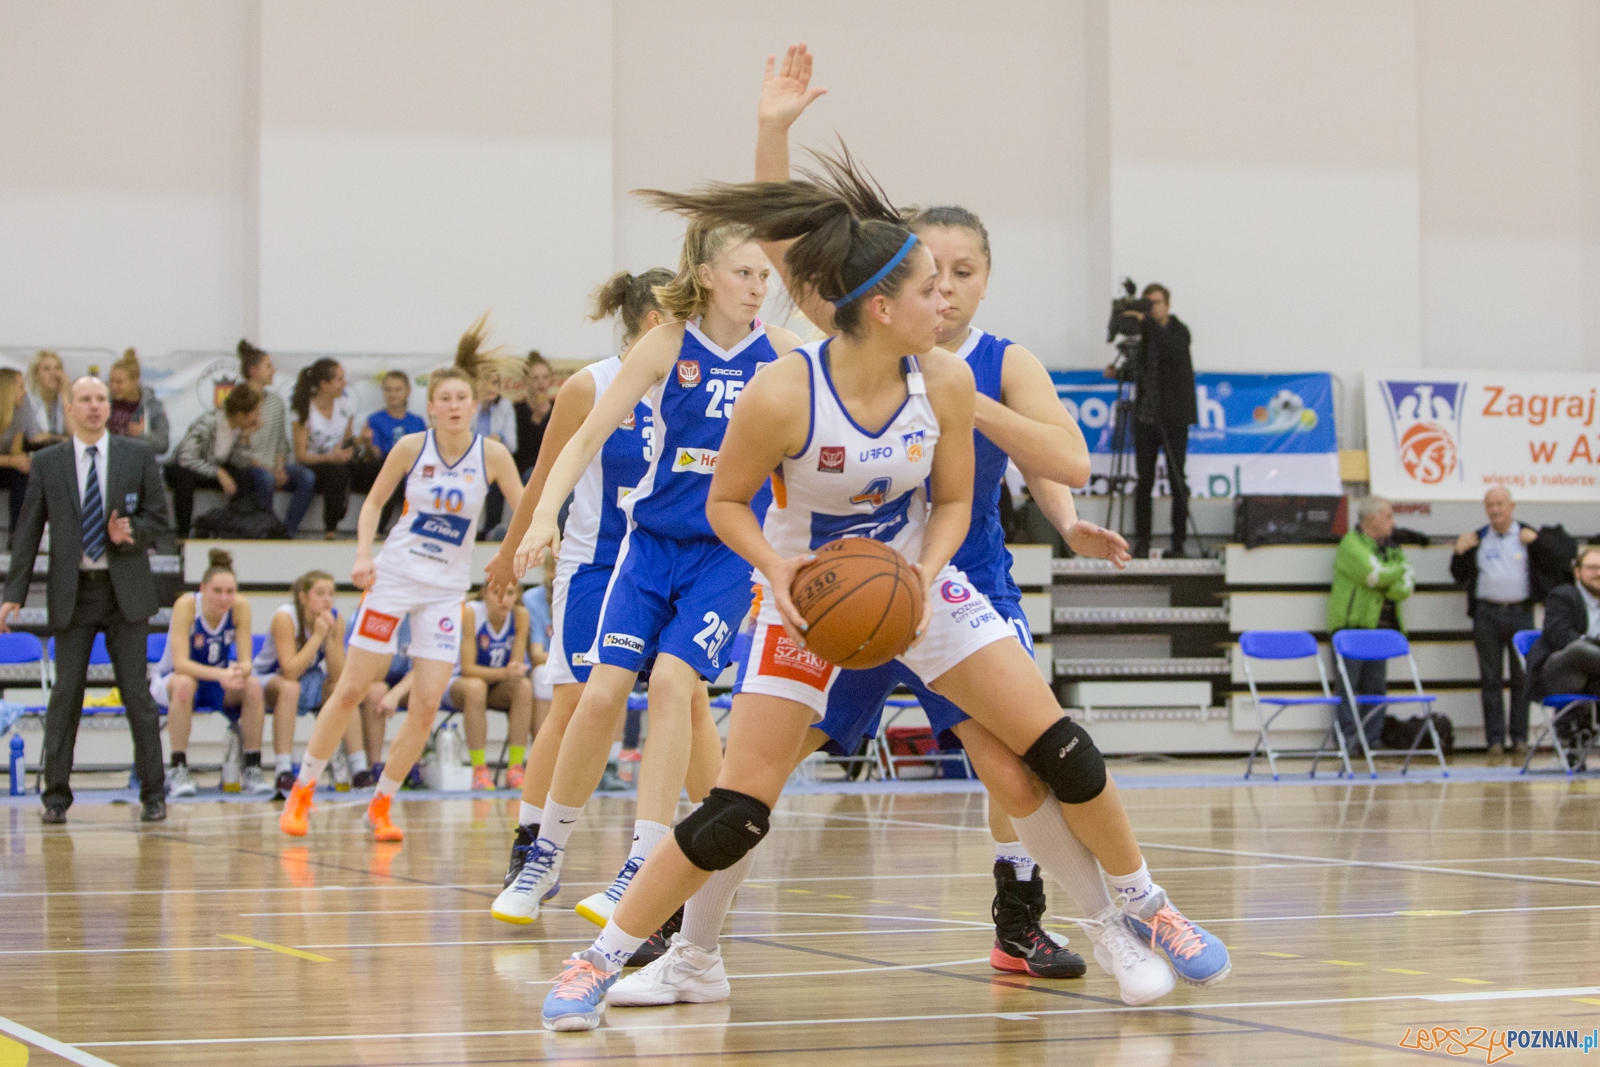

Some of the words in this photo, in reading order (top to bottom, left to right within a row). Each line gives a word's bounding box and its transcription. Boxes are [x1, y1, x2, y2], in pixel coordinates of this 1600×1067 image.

[705, 378, 745, 419] 25
[1482, 386, 1597, 427] Zagraj
[1529, 441, 1558, 464] w
[429, 485, 465, 514] 10
[849, 477, 893, 509] 4
